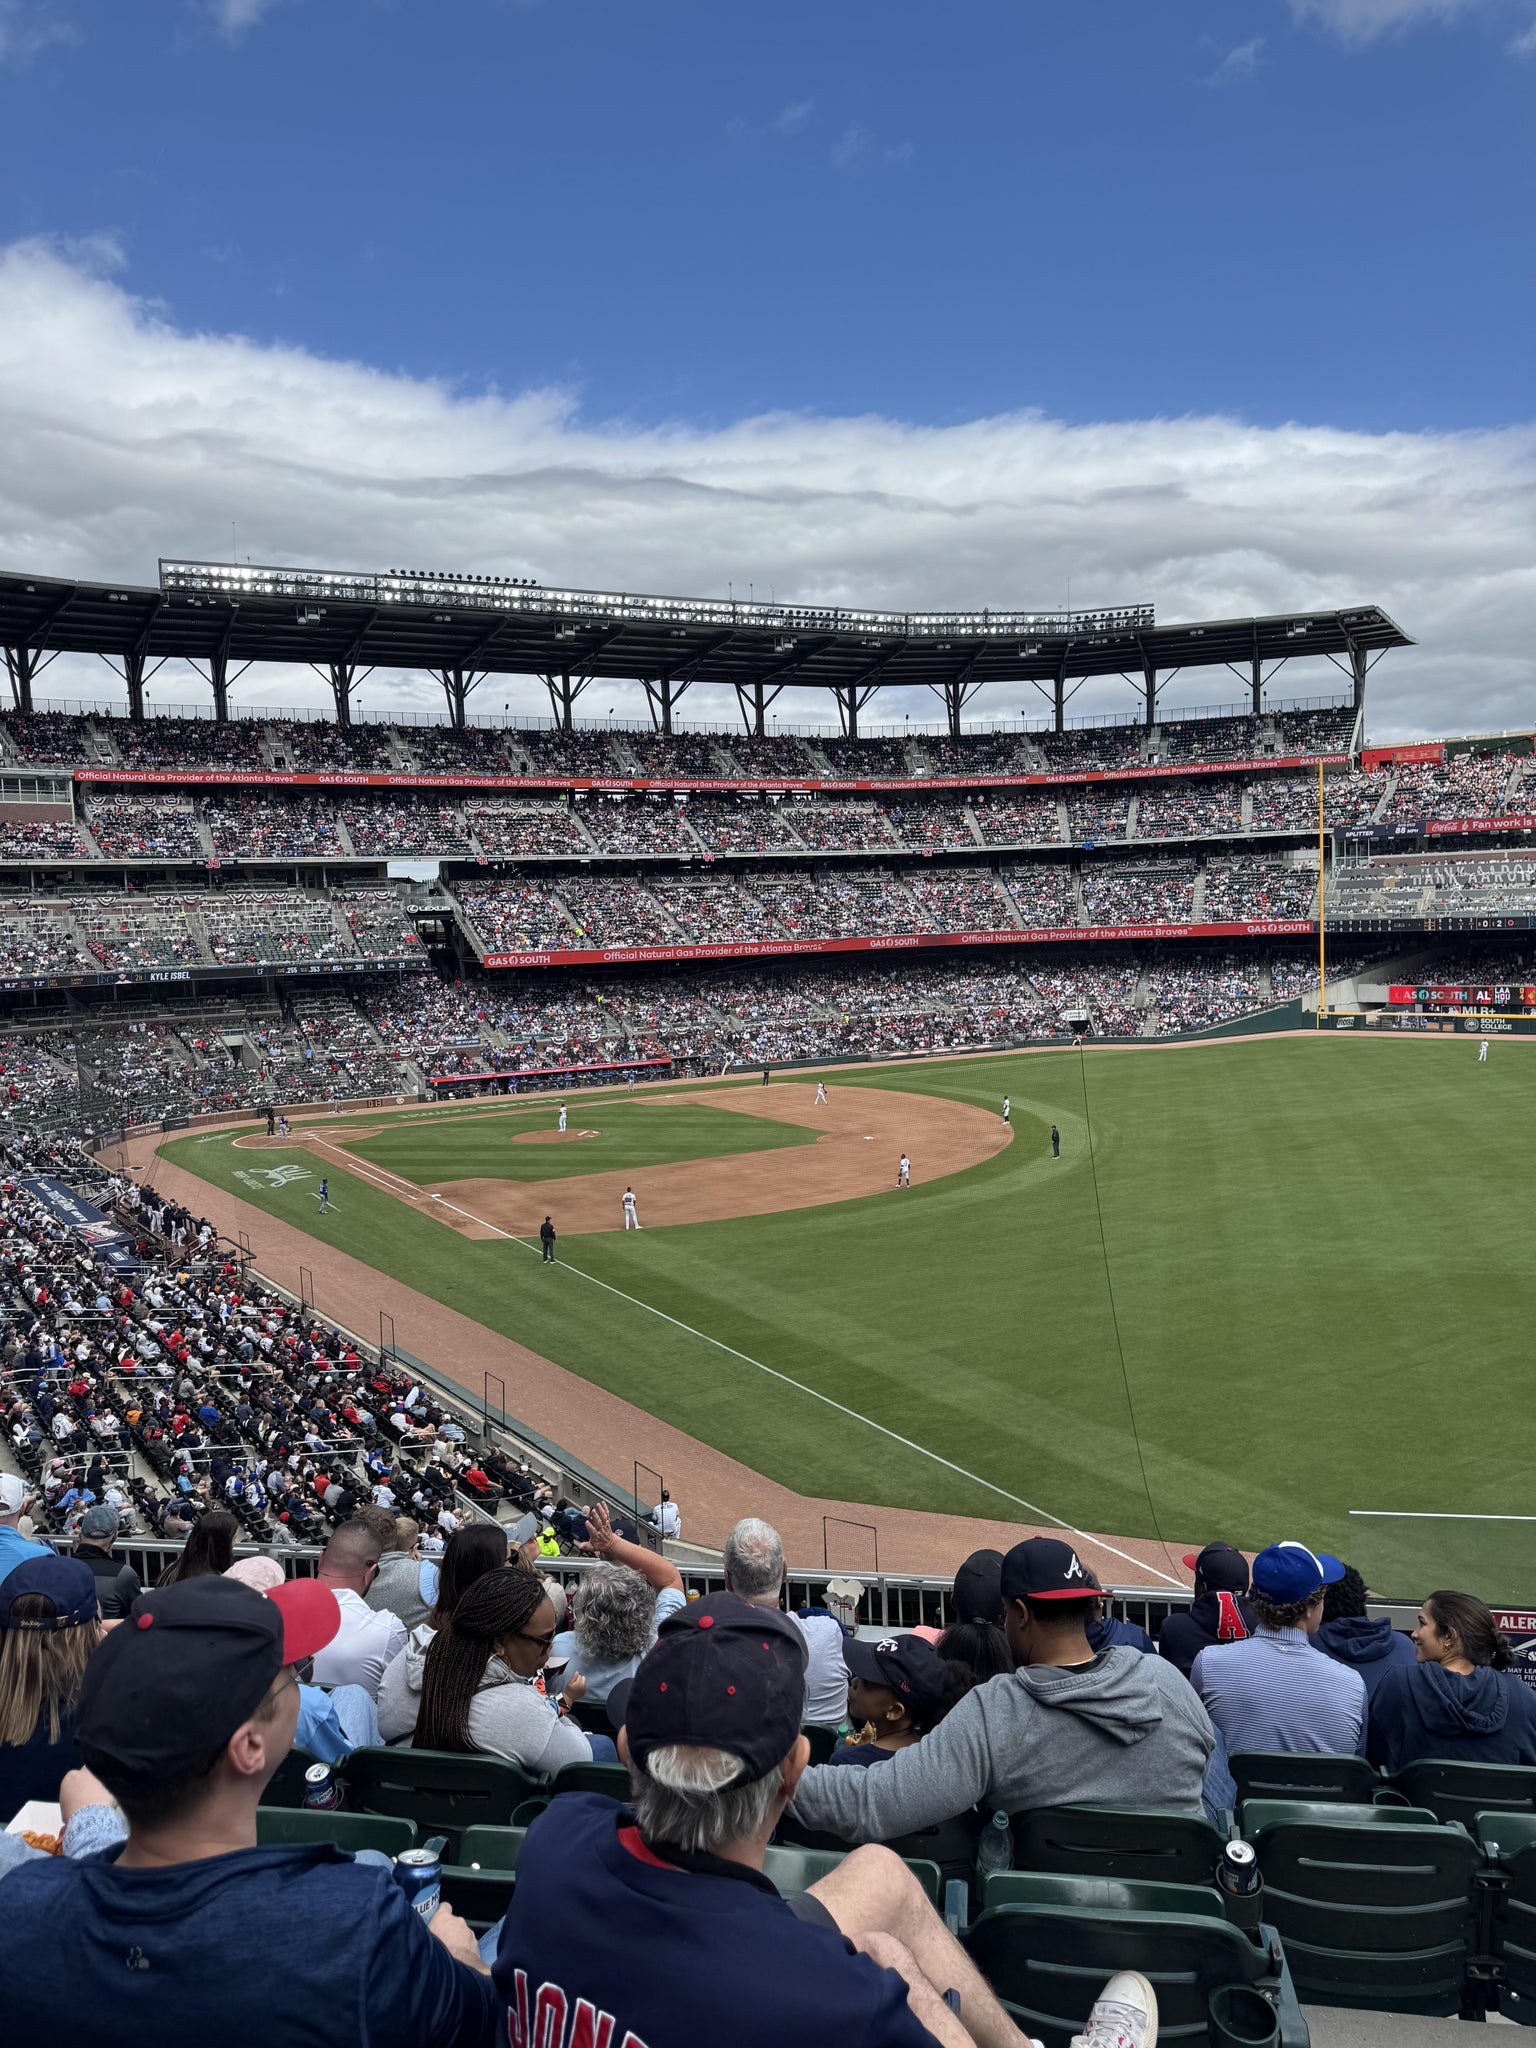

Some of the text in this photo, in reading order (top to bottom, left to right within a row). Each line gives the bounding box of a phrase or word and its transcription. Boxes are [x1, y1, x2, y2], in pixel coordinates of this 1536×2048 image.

[1172, 766, 1202, 774] Provider
[78, 772, 110, 780] Official
[1494, 819, 1520, 827] work
[1247, 924, 1310, 933] GAS SOUTH
[962, 934, 993, 943] Official
[995, 932, 1029, 941] Natural
[1030, 932, 1048, 940] Gas
[1050, 930, 1087, 939] Provider
[1089, 930, 1099, 938] of
[1100, 930, 1116, 938] the
[1118, 928, 1153, 937] Atlanta
[894, 937, 919, 946] SOUTH
[603, 951, 637, 960] Official
[640, 949, 674, 959] Natural
[675, 949, 694, 957] Gas
[695, 945, 732, 956] Provider
[734, 945, 743, 954] of
[744, 944, 759, 953] the
[760, 944, 792, 953] Atlanta
[488, 955, 551, 966] GAS SOUTH
[1476, 991, 1491, 1000] AL
[1064, 1554, 1082, 1580] A
[1216, 1592, 1247, 1639] A
[1500, 1616, 1536, 1629] ALER
[415, 1902, 430, 1913] LUE
[508, 1968, 648, 2048] JON
